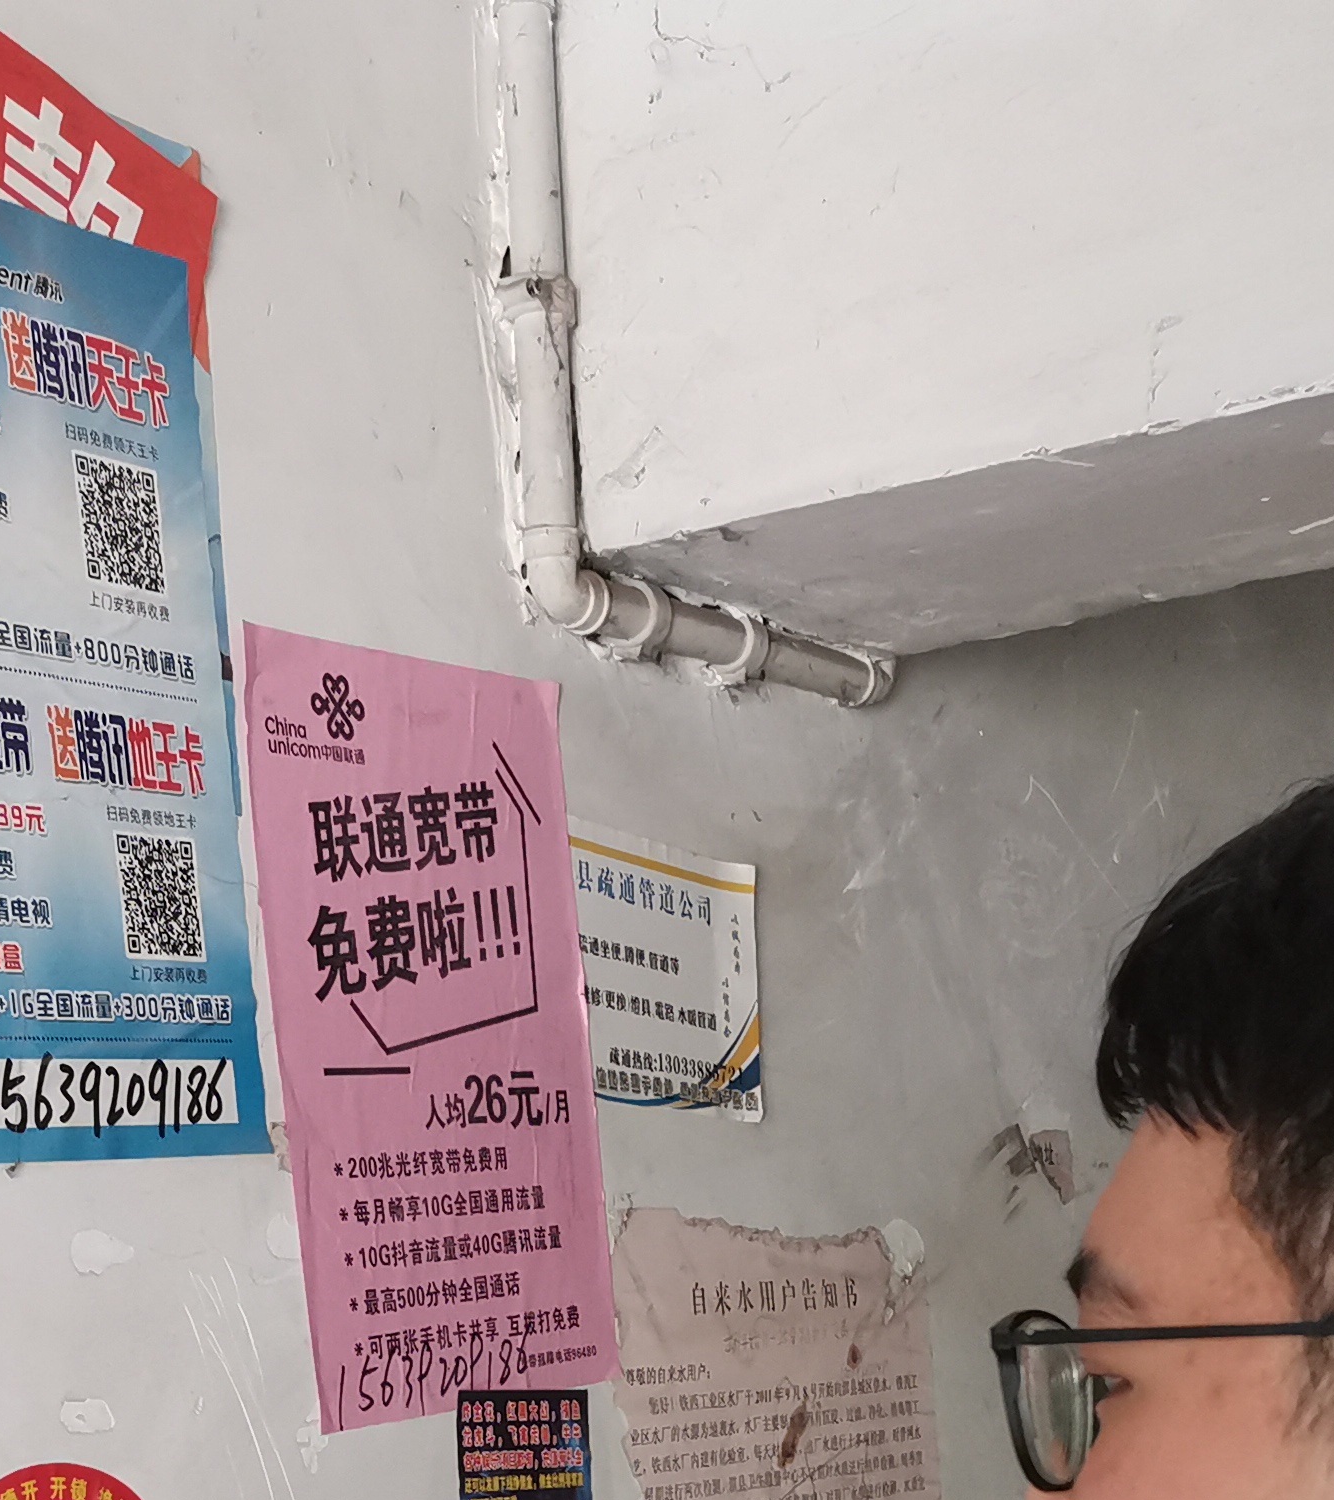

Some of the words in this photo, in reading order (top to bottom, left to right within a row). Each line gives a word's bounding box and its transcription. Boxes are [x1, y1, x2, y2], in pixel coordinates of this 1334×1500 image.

[33, 274, 65, 303] 腾讯
[1, 306, 169, 428] 送腾讯天王卡
[65, 422, 160, 461] 扫码免费领天王卡
[90, 591, 170, 623] 上门安装再收费
[45, 703, 207, 798] 送腾讯地王卡
[264, 714, 307, 740] China
[308, 781, 500, 883] 联通宽带
[577, 859, 712, 926] 县疏通管道公司
[425, 1070, 572, 1130] 人均26元/月
[691, 1276, 858, 1317] 自来水用户告知书
